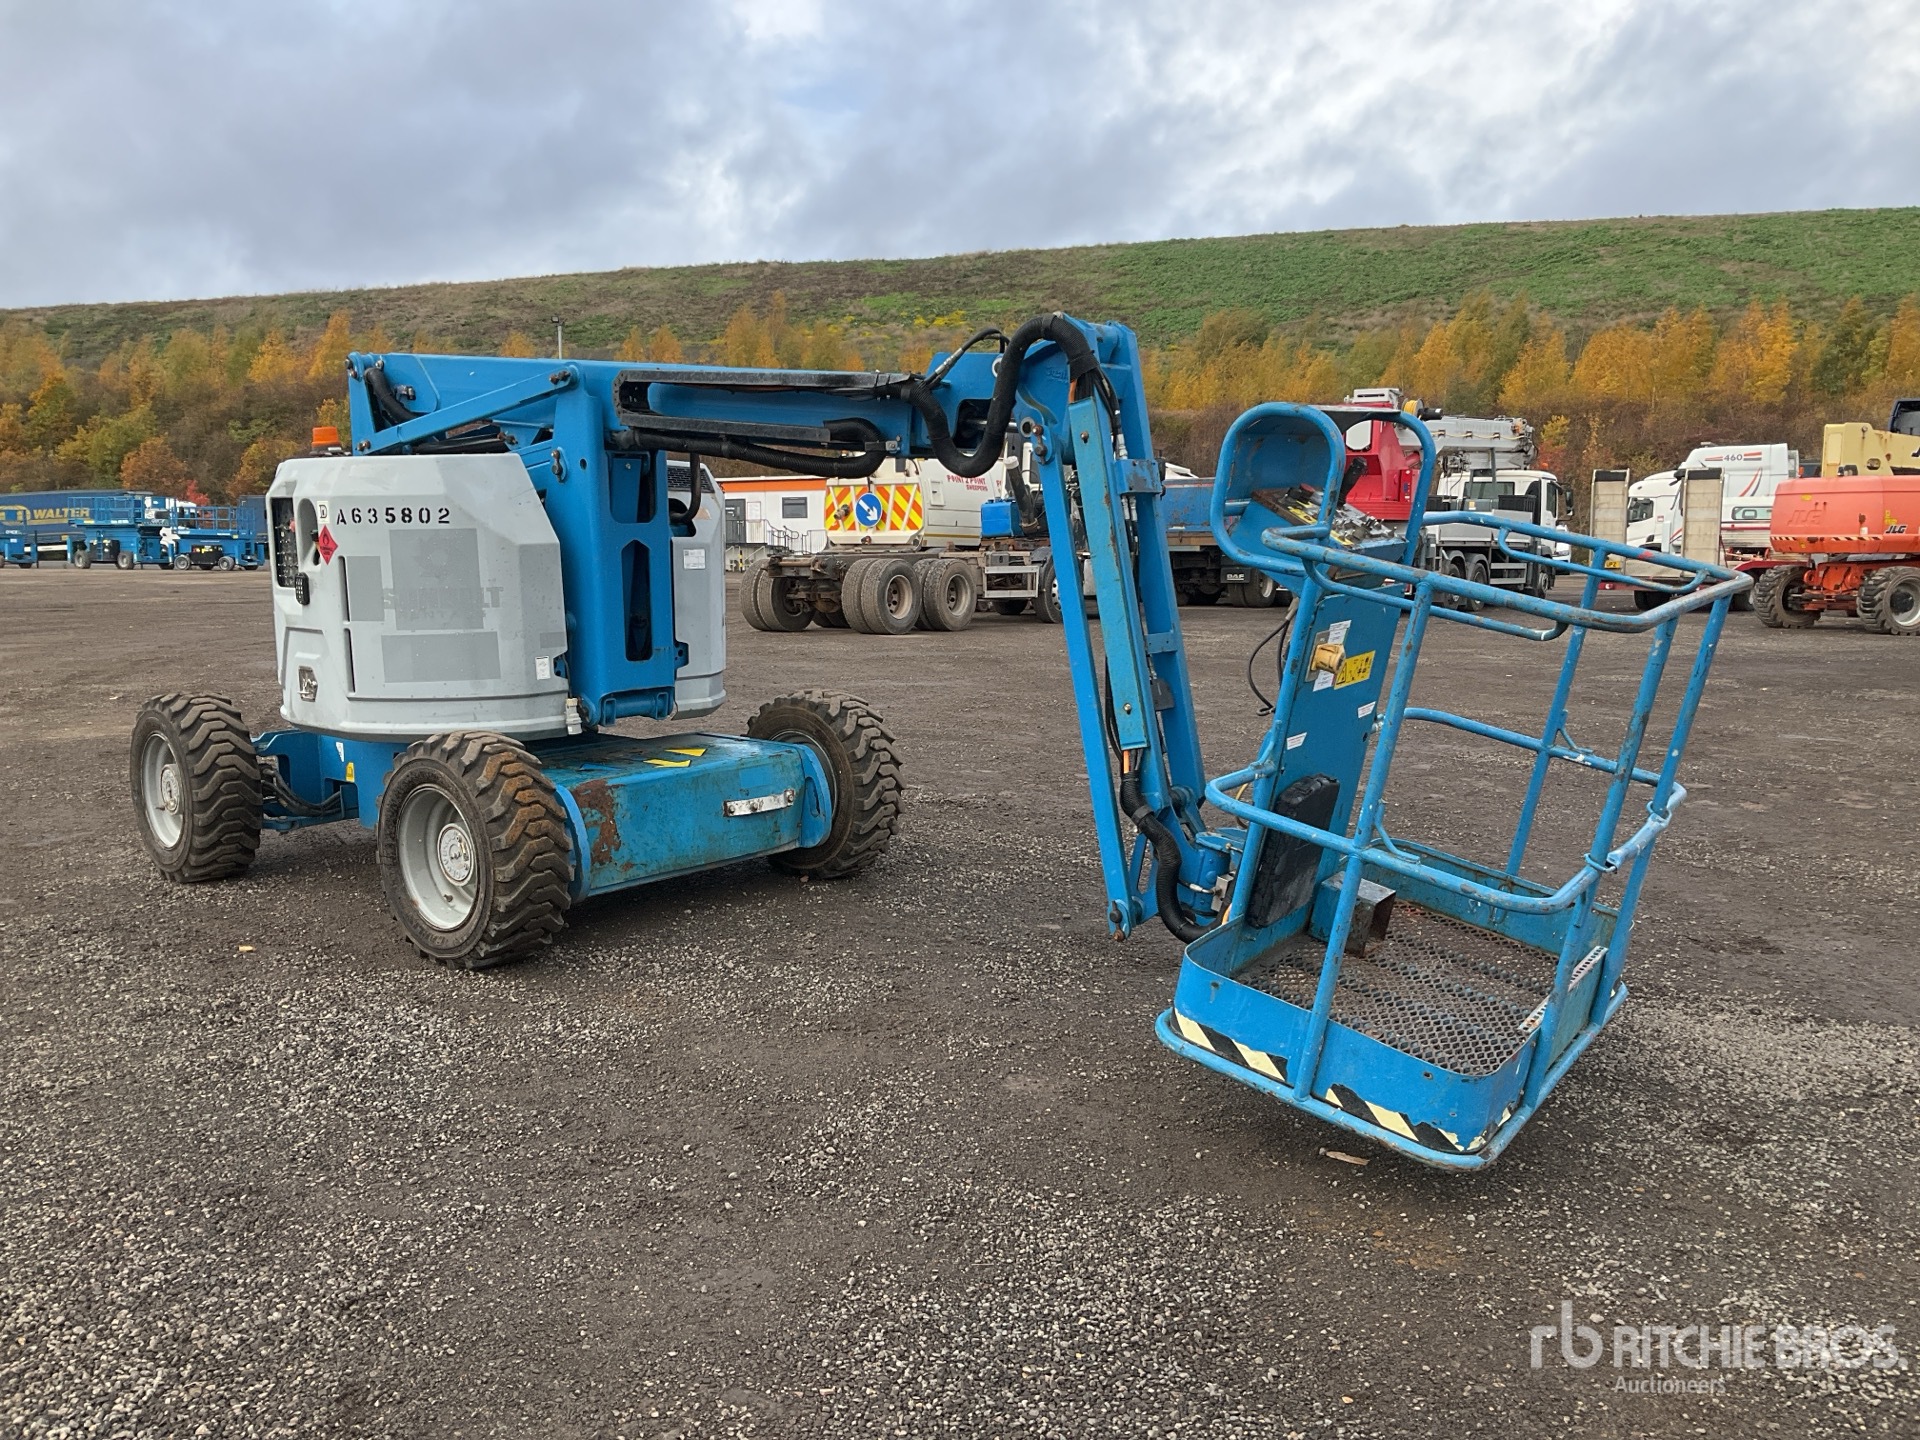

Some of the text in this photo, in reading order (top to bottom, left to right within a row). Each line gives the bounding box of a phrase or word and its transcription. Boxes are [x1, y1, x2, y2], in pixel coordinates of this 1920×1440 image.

[1724, 453, 1743, 461] 460
[33, 507, 90, 519] WALTER
[336, 507, 451, 525] A635802
[1787, 509, 1822, 527] JLG
[1885, 525, 1907, 534] JLG
